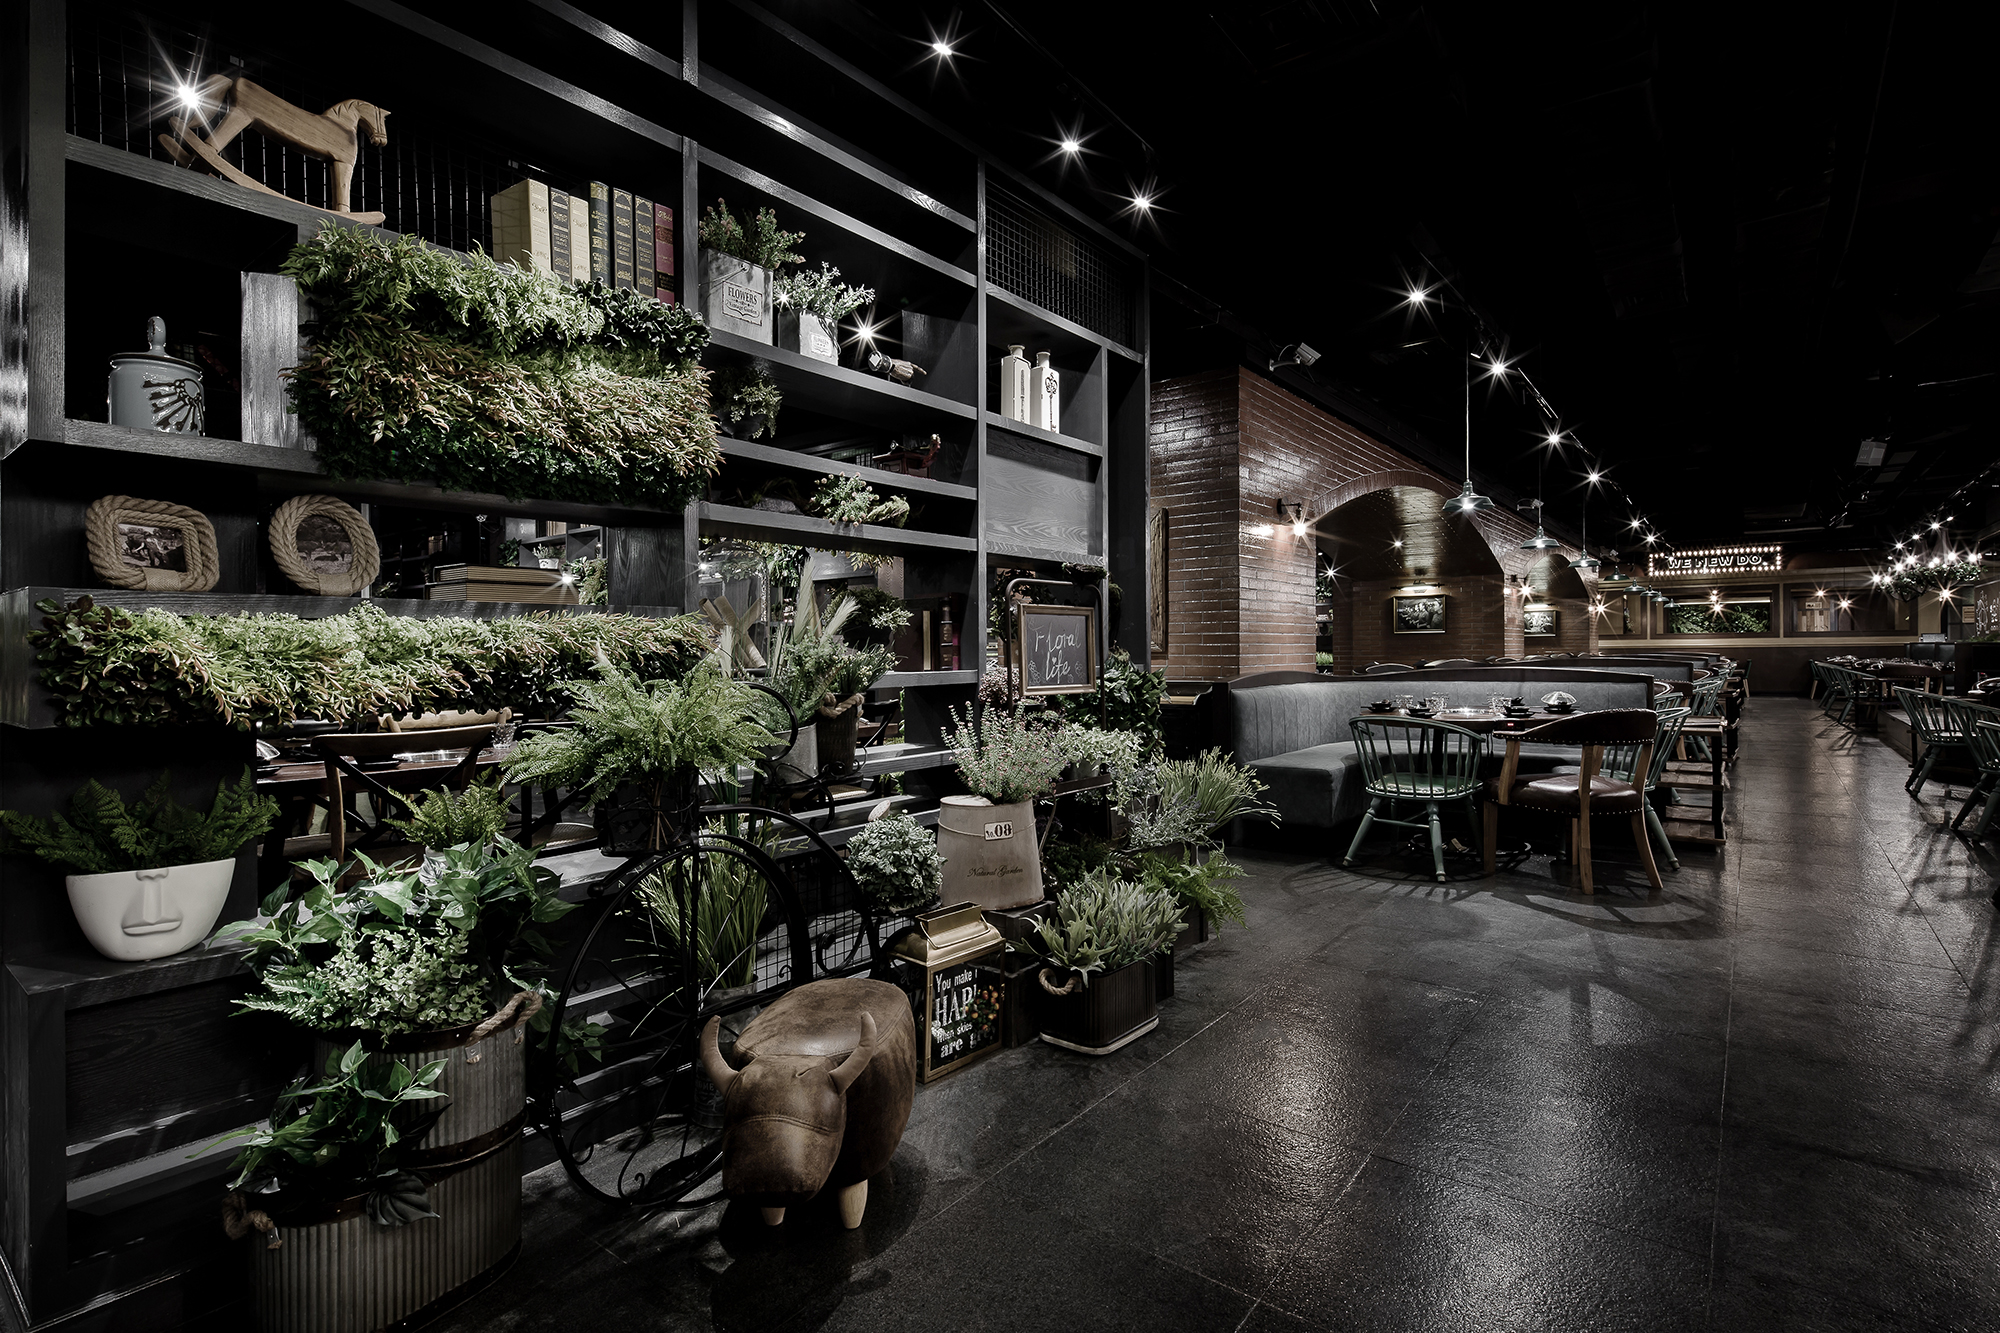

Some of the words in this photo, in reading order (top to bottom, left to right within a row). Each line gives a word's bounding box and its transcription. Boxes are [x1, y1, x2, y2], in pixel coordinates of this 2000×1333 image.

[728, 286, 758, 305] FLOWERS
[1668, 556, 1692, 569] WE
[1029, 621, 1081, 653] Floral
[967, 867, 997, 878] Natural
[997, 864, 1024, 878] Garden
[935, 972, 952, 993] You
[954, 968, 973, 986] make
[957, 1021, 973, 1035] skies
[940, 1037, 964, 1059] are
